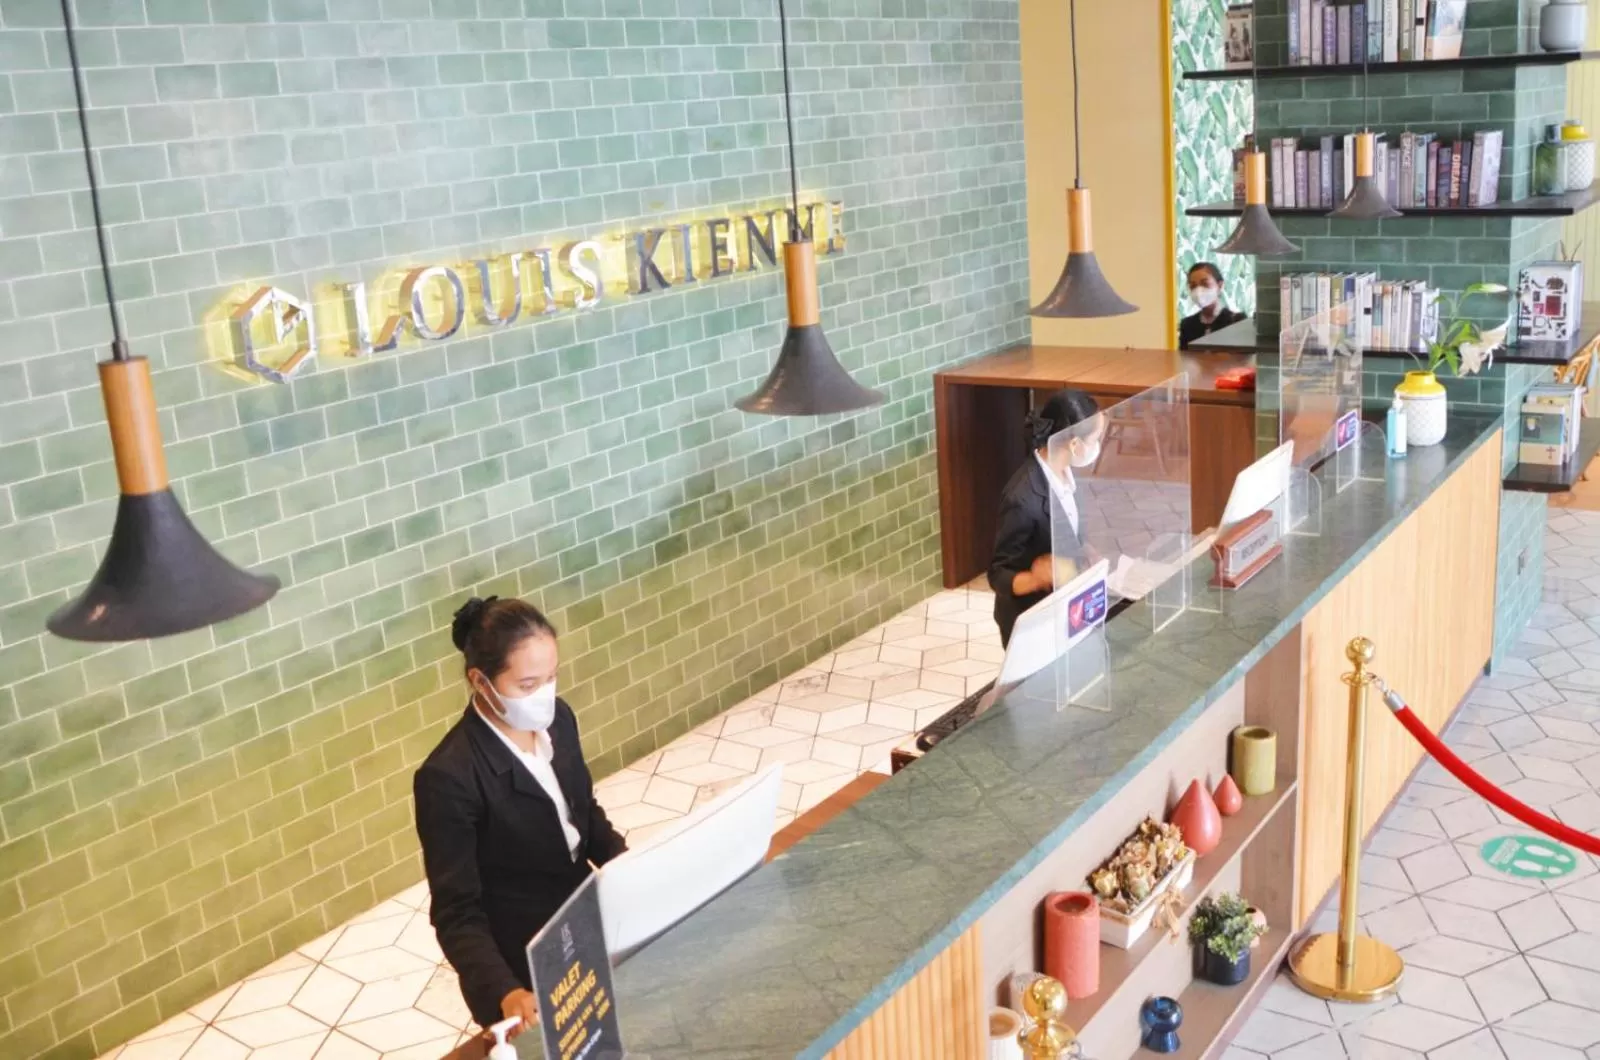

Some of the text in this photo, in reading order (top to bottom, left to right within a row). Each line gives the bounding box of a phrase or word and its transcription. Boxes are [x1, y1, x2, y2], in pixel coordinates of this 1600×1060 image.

[1450, 153, 1461, 199] DREAMS
[344, 240, 605, 357] LOUIS
[550, 961, 580, 1006] VALET
[554, 969, 596, 1031] PARKING
